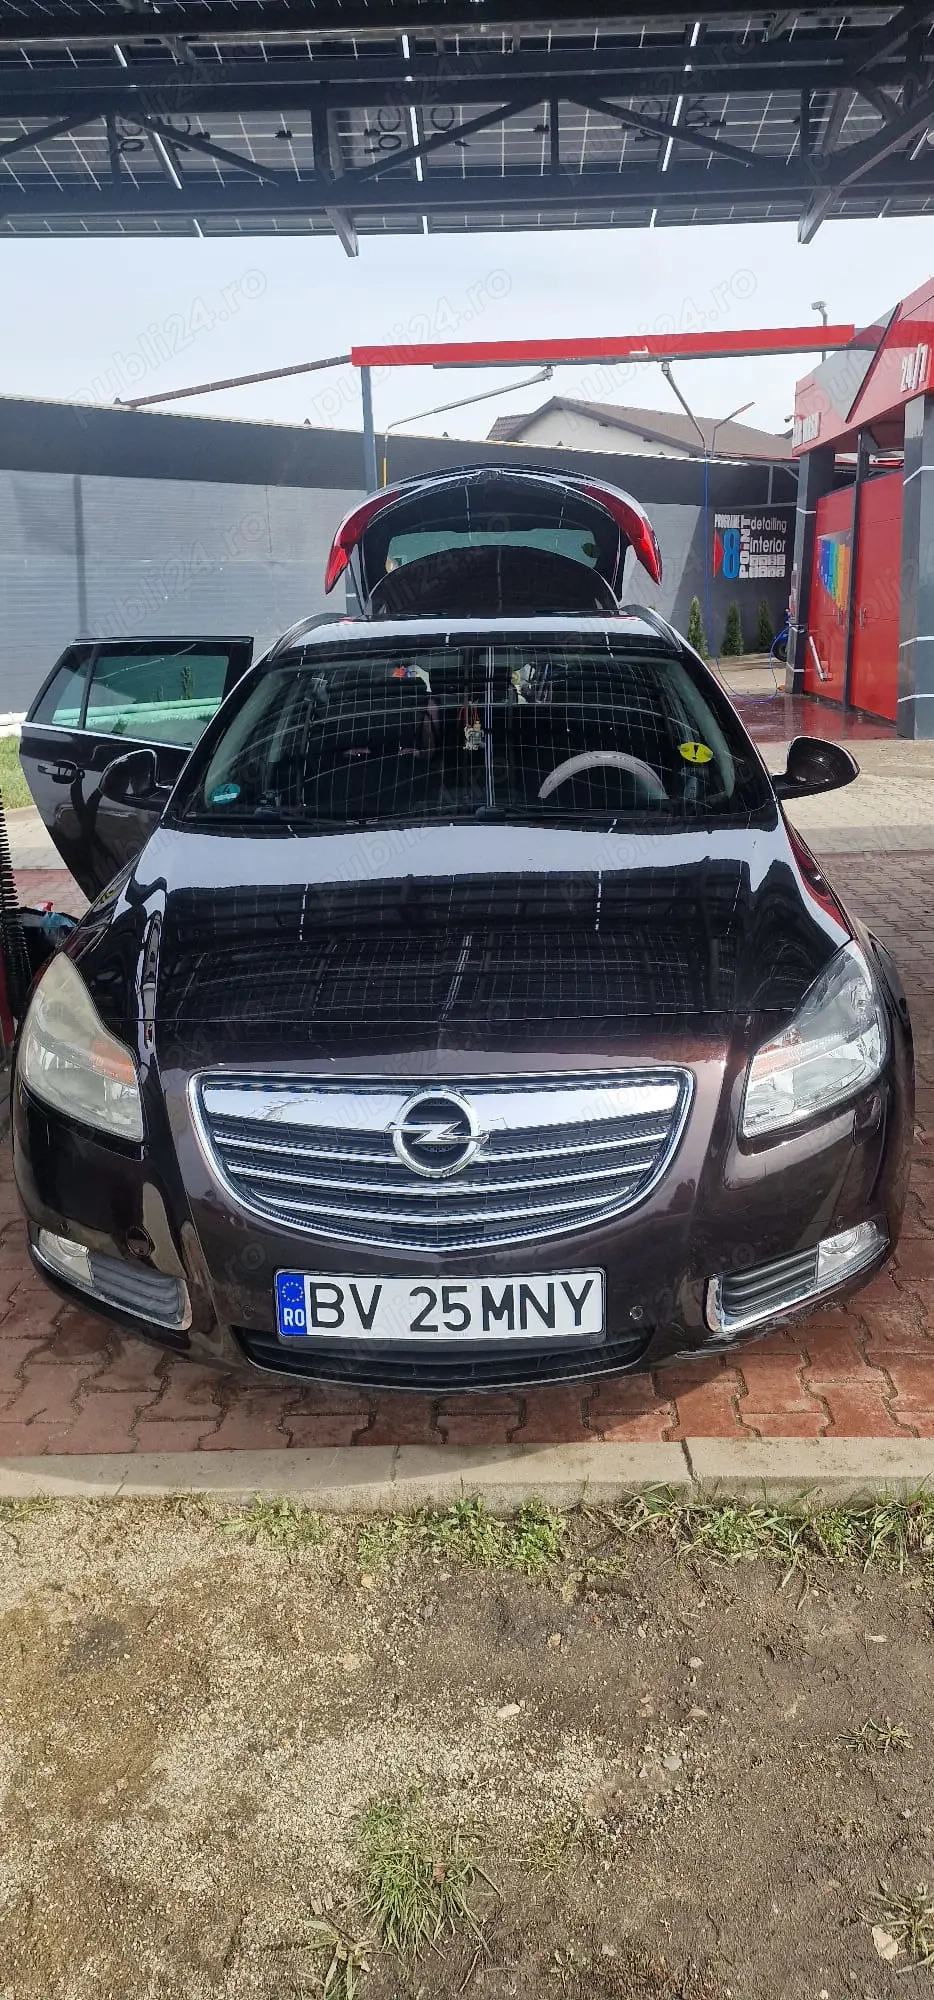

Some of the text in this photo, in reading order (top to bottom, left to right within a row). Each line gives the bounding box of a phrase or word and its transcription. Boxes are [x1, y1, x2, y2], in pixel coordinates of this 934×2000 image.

[750, 517, 787, 533] detailing
[723, 528, 740, 578] 8
[749, 536, 785, 553] interior
[309, 1279, 595, 1332] BV 25 MNY
[283, 1307, 306, 1327] RO
